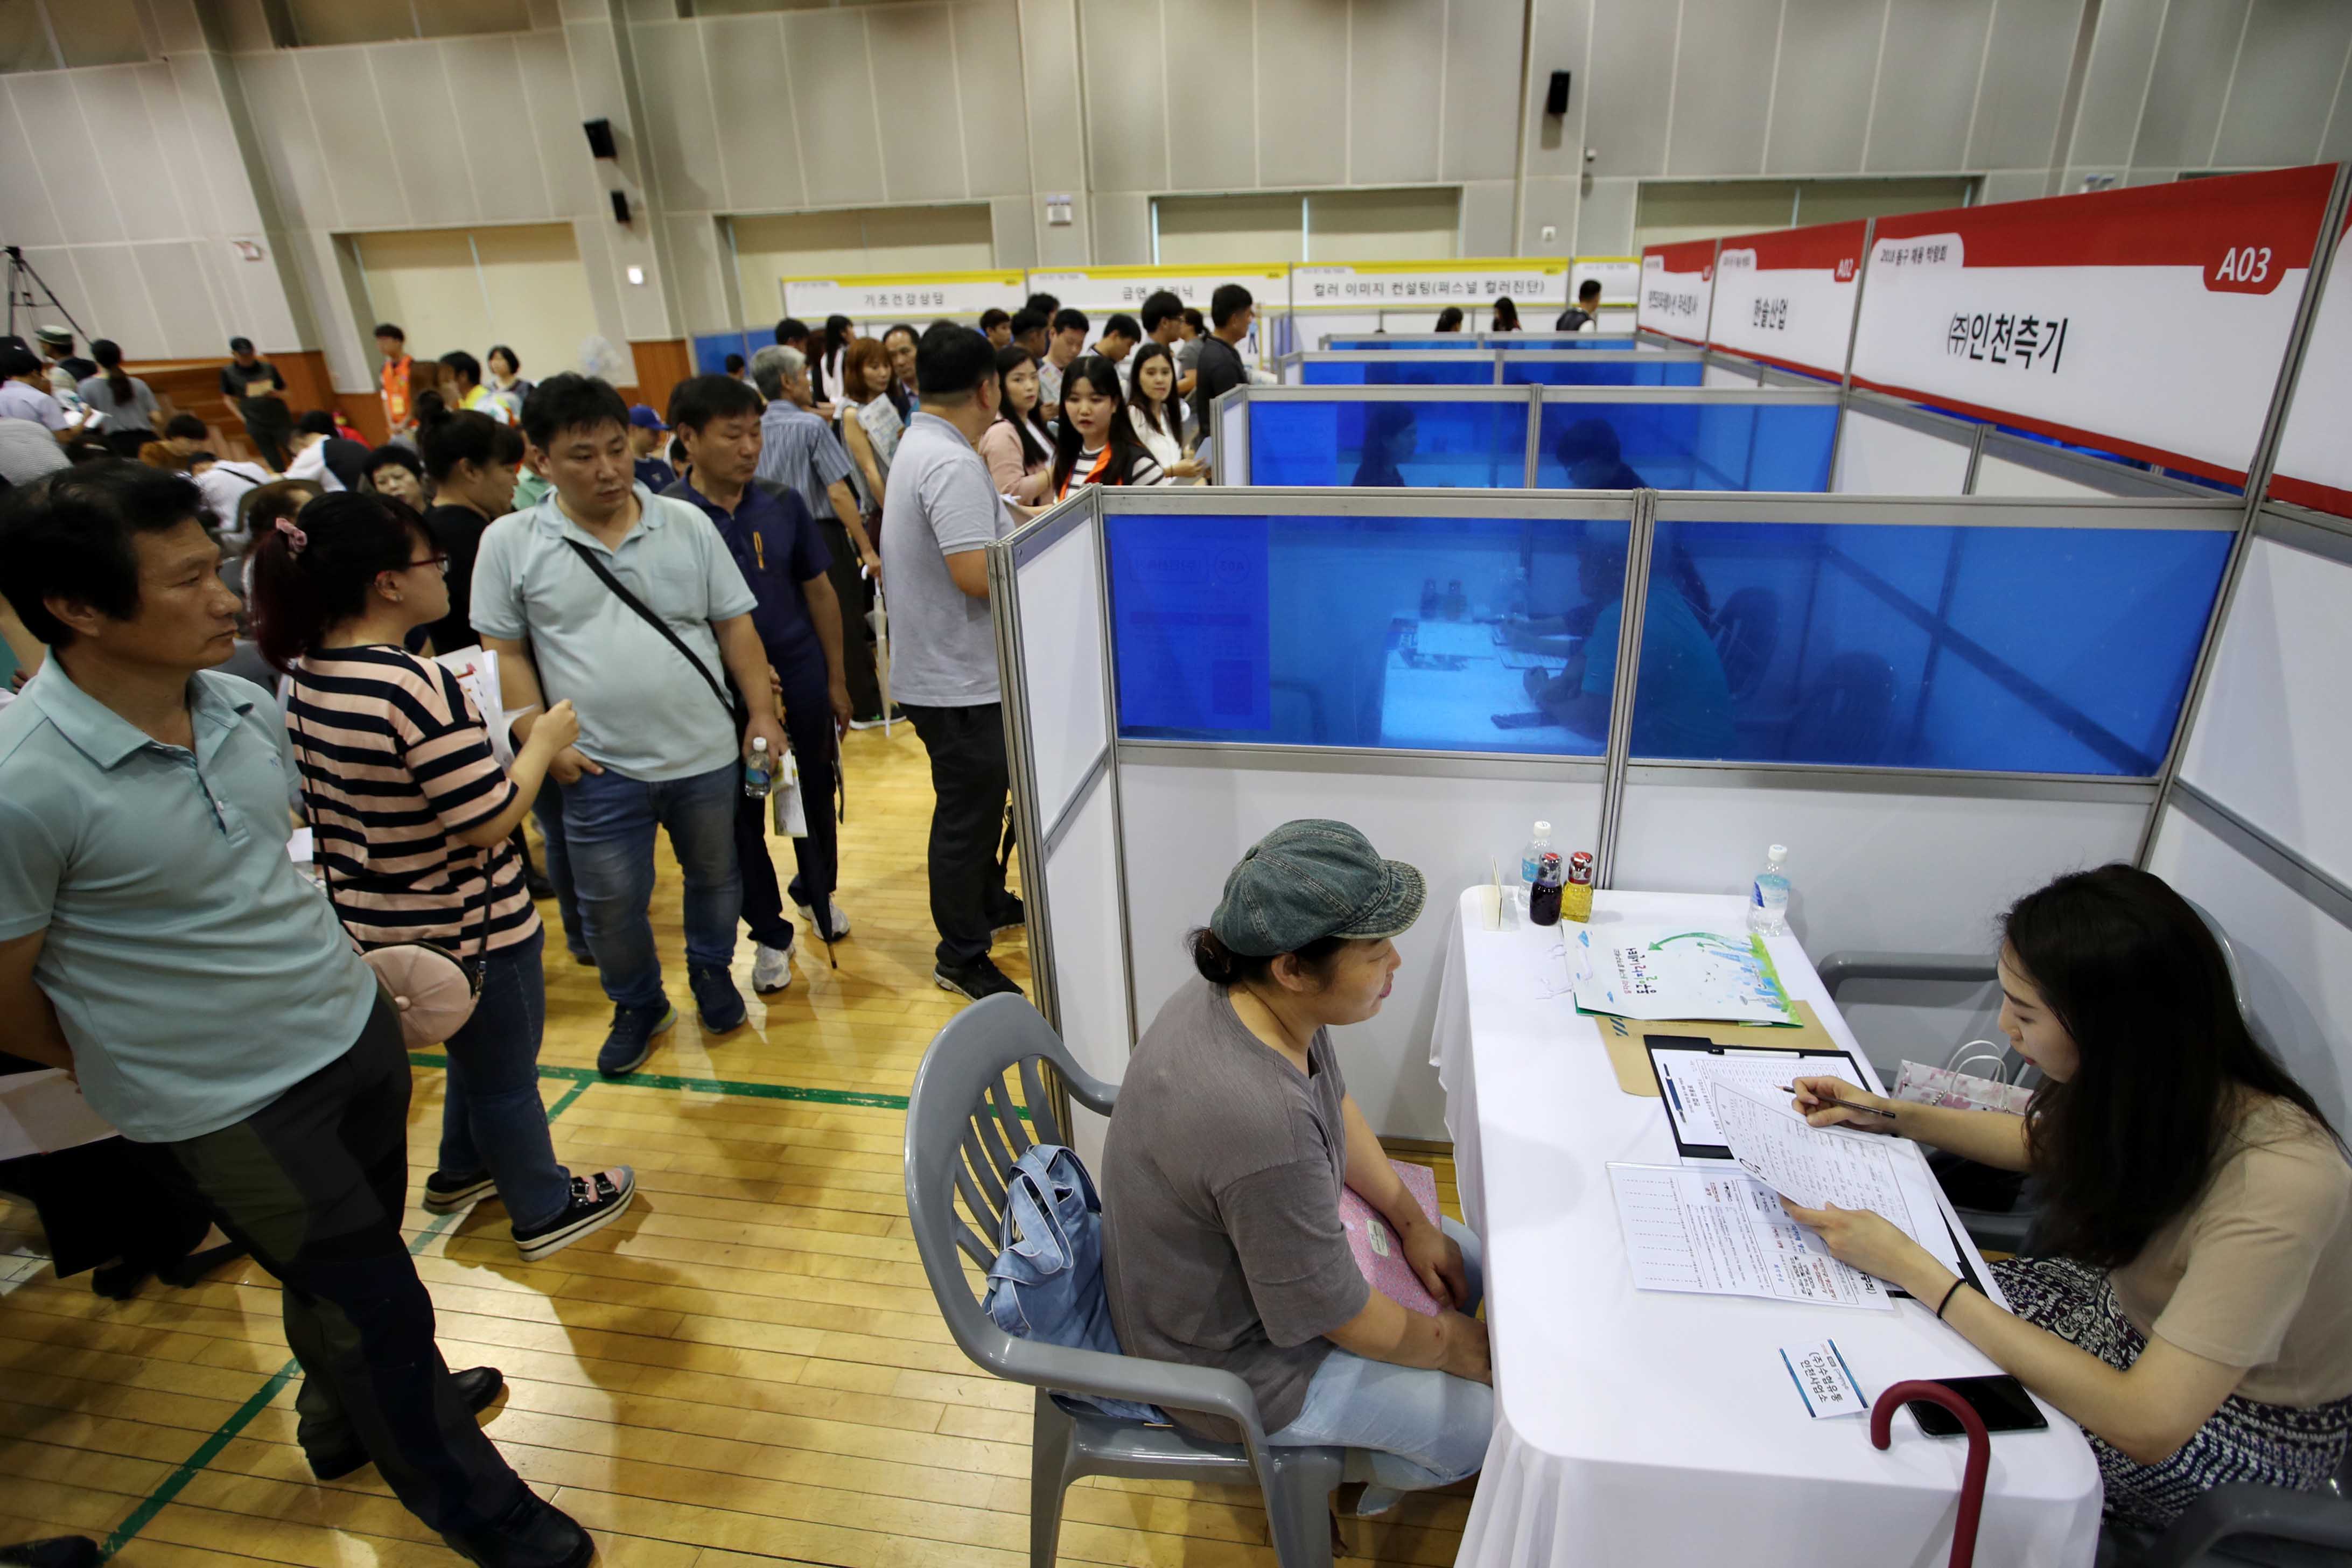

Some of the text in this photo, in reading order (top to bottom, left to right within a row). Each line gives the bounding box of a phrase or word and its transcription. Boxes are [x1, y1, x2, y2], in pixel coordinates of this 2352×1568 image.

[1926, 244, 1949, 263] 박람회
[1837, 258, 1854, 278] A02
[2215, 247, 2272, 283] A03
[864, 291, 944, 307] 기초건강상담
[1122, 285, 1147, 300] 금연
[1313, 282, 1339, 297] 컬러
[1345, 281, 1385, 296] 이미지
[1946, 311, 2069, 375] (주)인천측기
[1799, 1360, 1829, 1403] 인천사업소
[1809, 1350, 1844, 1403] (주)수협유통
